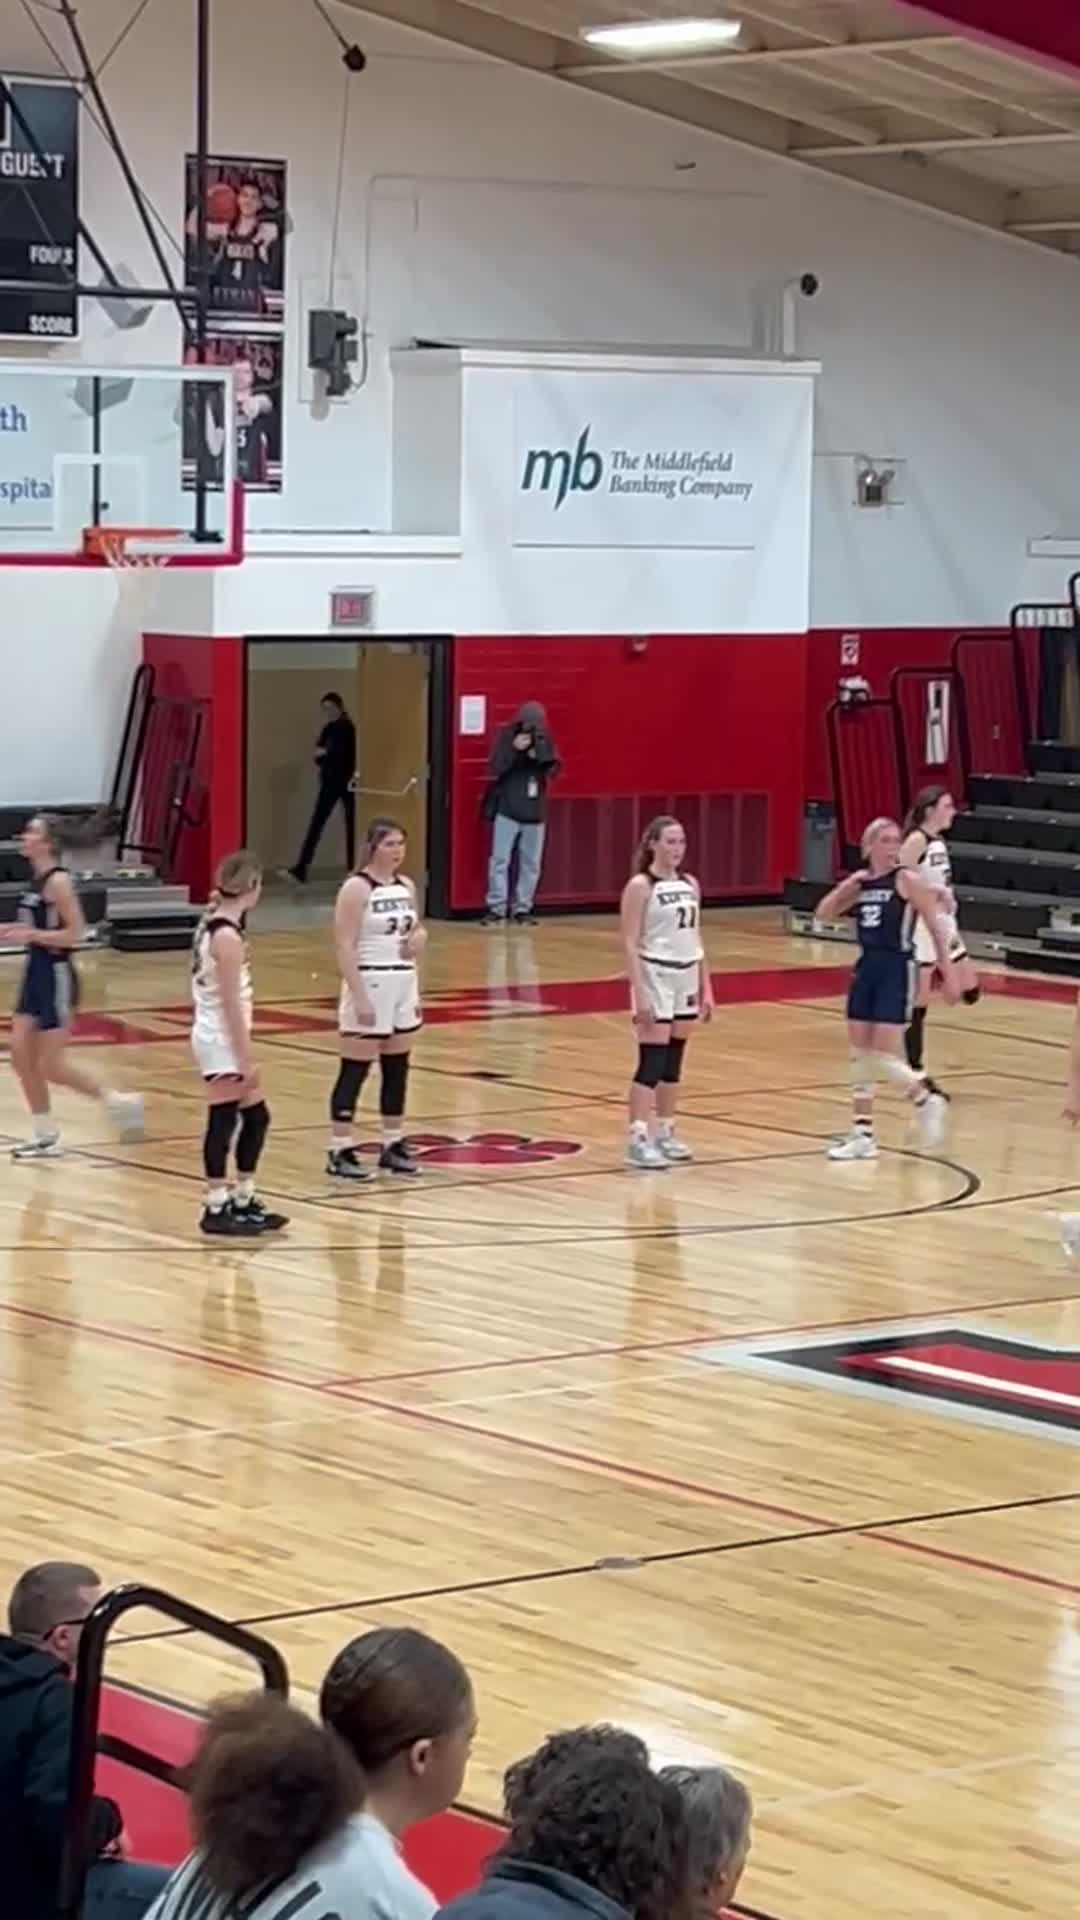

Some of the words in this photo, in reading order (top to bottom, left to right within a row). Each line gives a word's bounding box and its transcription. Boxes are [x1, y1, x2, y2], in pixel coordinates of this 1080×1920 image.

[29, 315, 73, 333] SCORE
[521, 422, 603, 511] mb
[610, 451, 638, 469] The
[643, 452, 733, 474] Middlefield
[609, 475, 676, 498] Banking
[679, 476, 752, 501] Company
